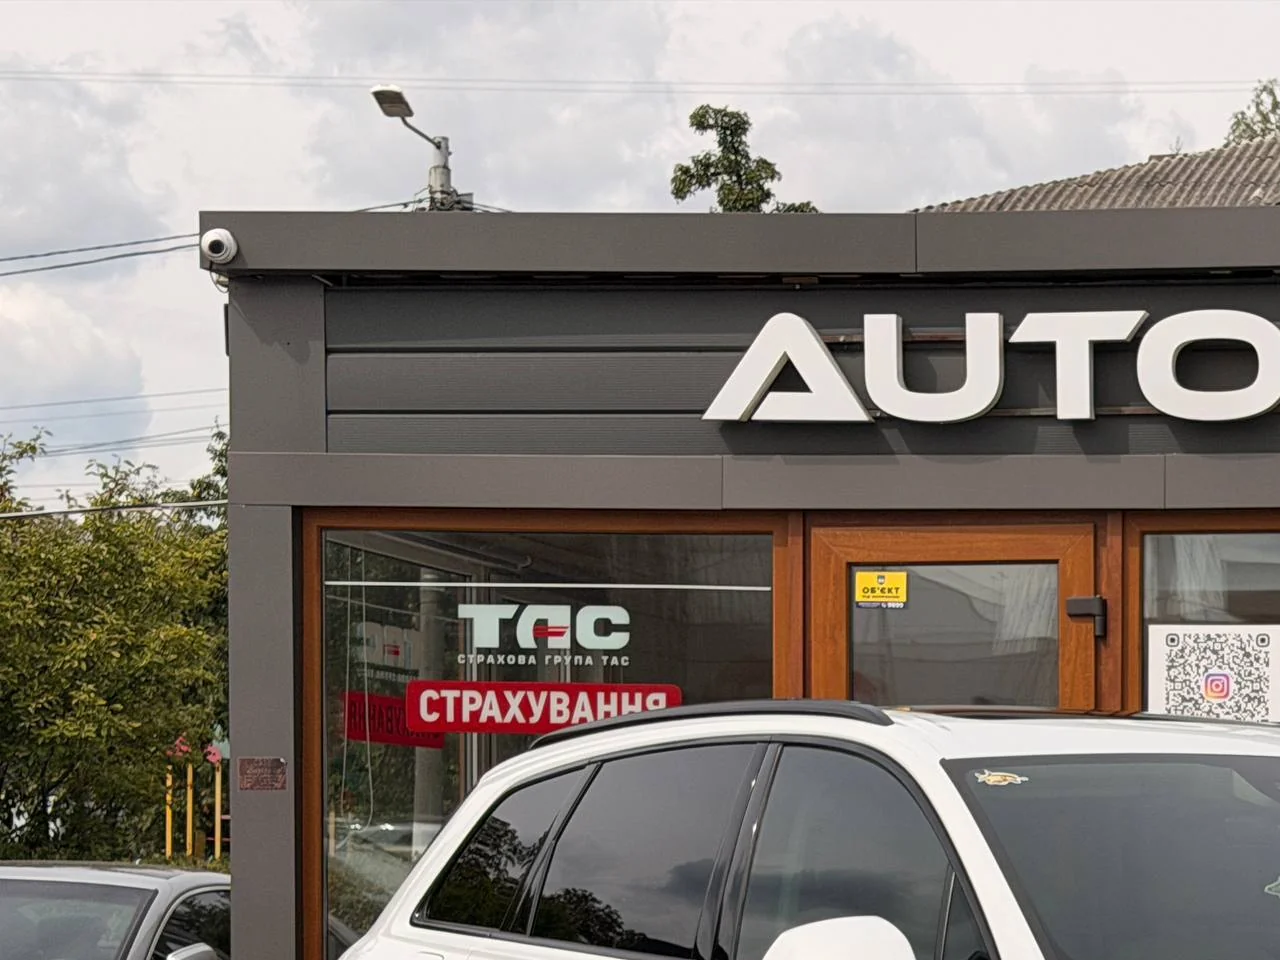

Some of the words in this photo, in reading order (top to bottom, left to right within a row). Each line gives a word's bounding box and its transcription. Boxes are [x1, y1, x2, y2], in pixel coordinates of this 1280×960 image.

[457, 653, 537, 666] СТРАХОВА
[545, 654, 594, 667] ГРУПА
[602, 655, 630, 667] ТАС
[419, 688, 667, 725] СТРАХУВАННЯ
